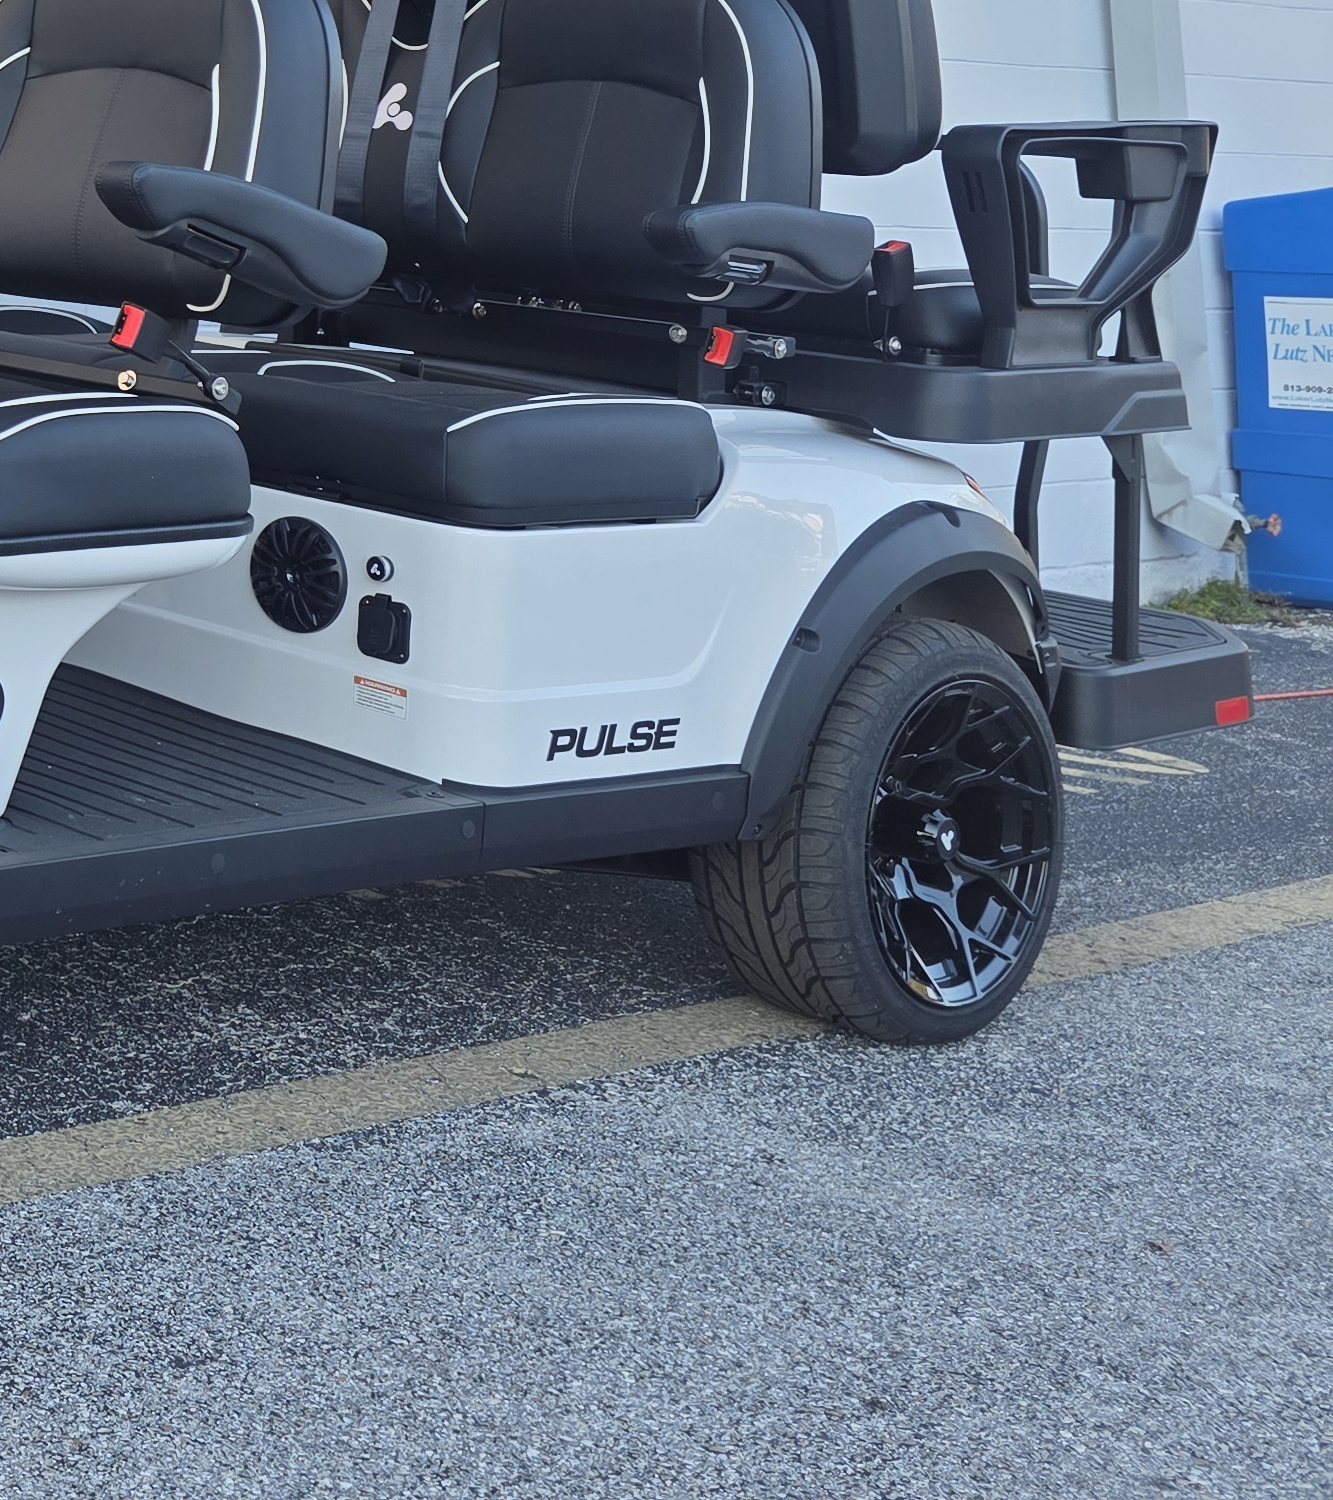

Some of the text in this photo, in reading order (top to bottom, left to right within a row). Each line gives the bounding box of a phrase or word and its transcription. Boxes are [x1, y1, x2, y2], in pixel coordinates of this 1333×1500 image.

[1268, 317, 1301, 336] The
[1272, 342, 1309, 364] Lutz
[1282, 383, 1333, 395] 813-909-2
[545, 717, 682, 762] PULSE
